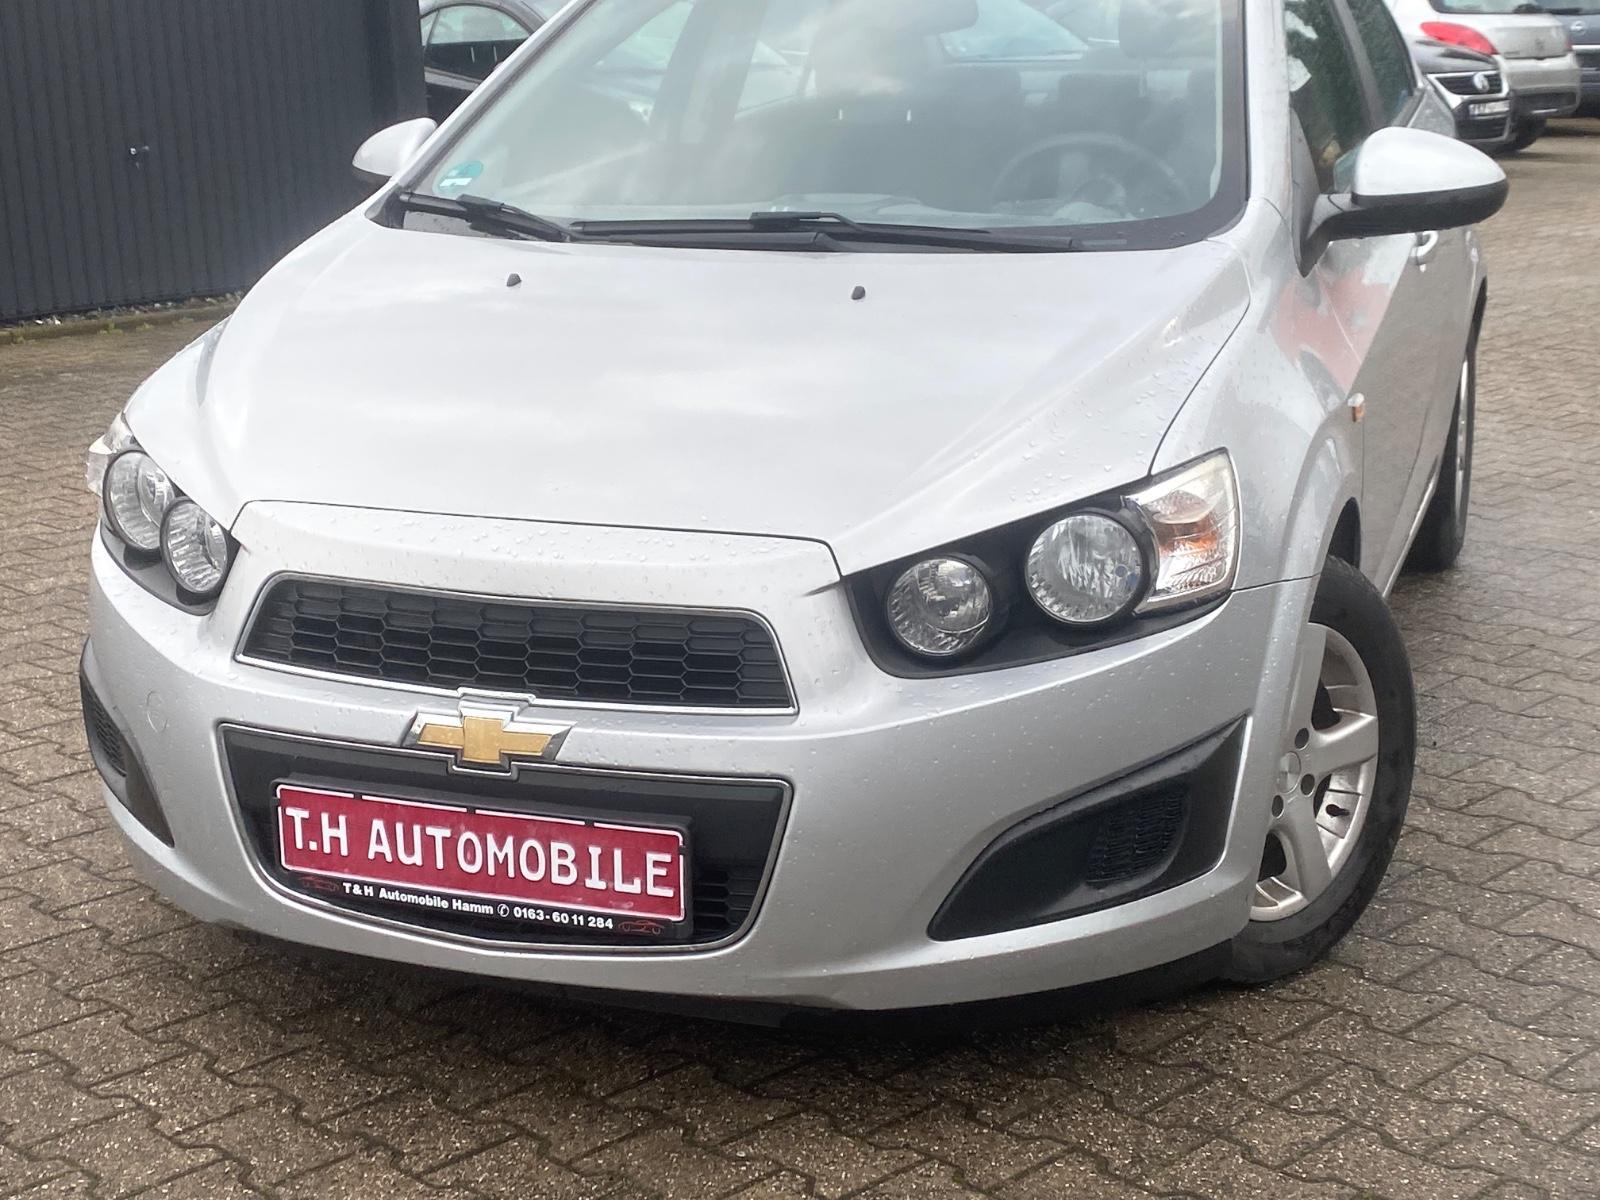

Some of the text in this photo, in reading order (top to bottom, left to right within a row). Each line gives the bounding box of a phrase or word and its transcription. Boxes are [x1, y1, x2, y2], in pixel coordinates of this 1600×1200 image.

[285, 807, 675, 898] T.H AUTOMOBILE
[379, 887, 449, 909] Automobile
[452, 899, 494, 915] Hamm
[571, 914, 585, 926] 11
[587, 916, 614, 929] 284
